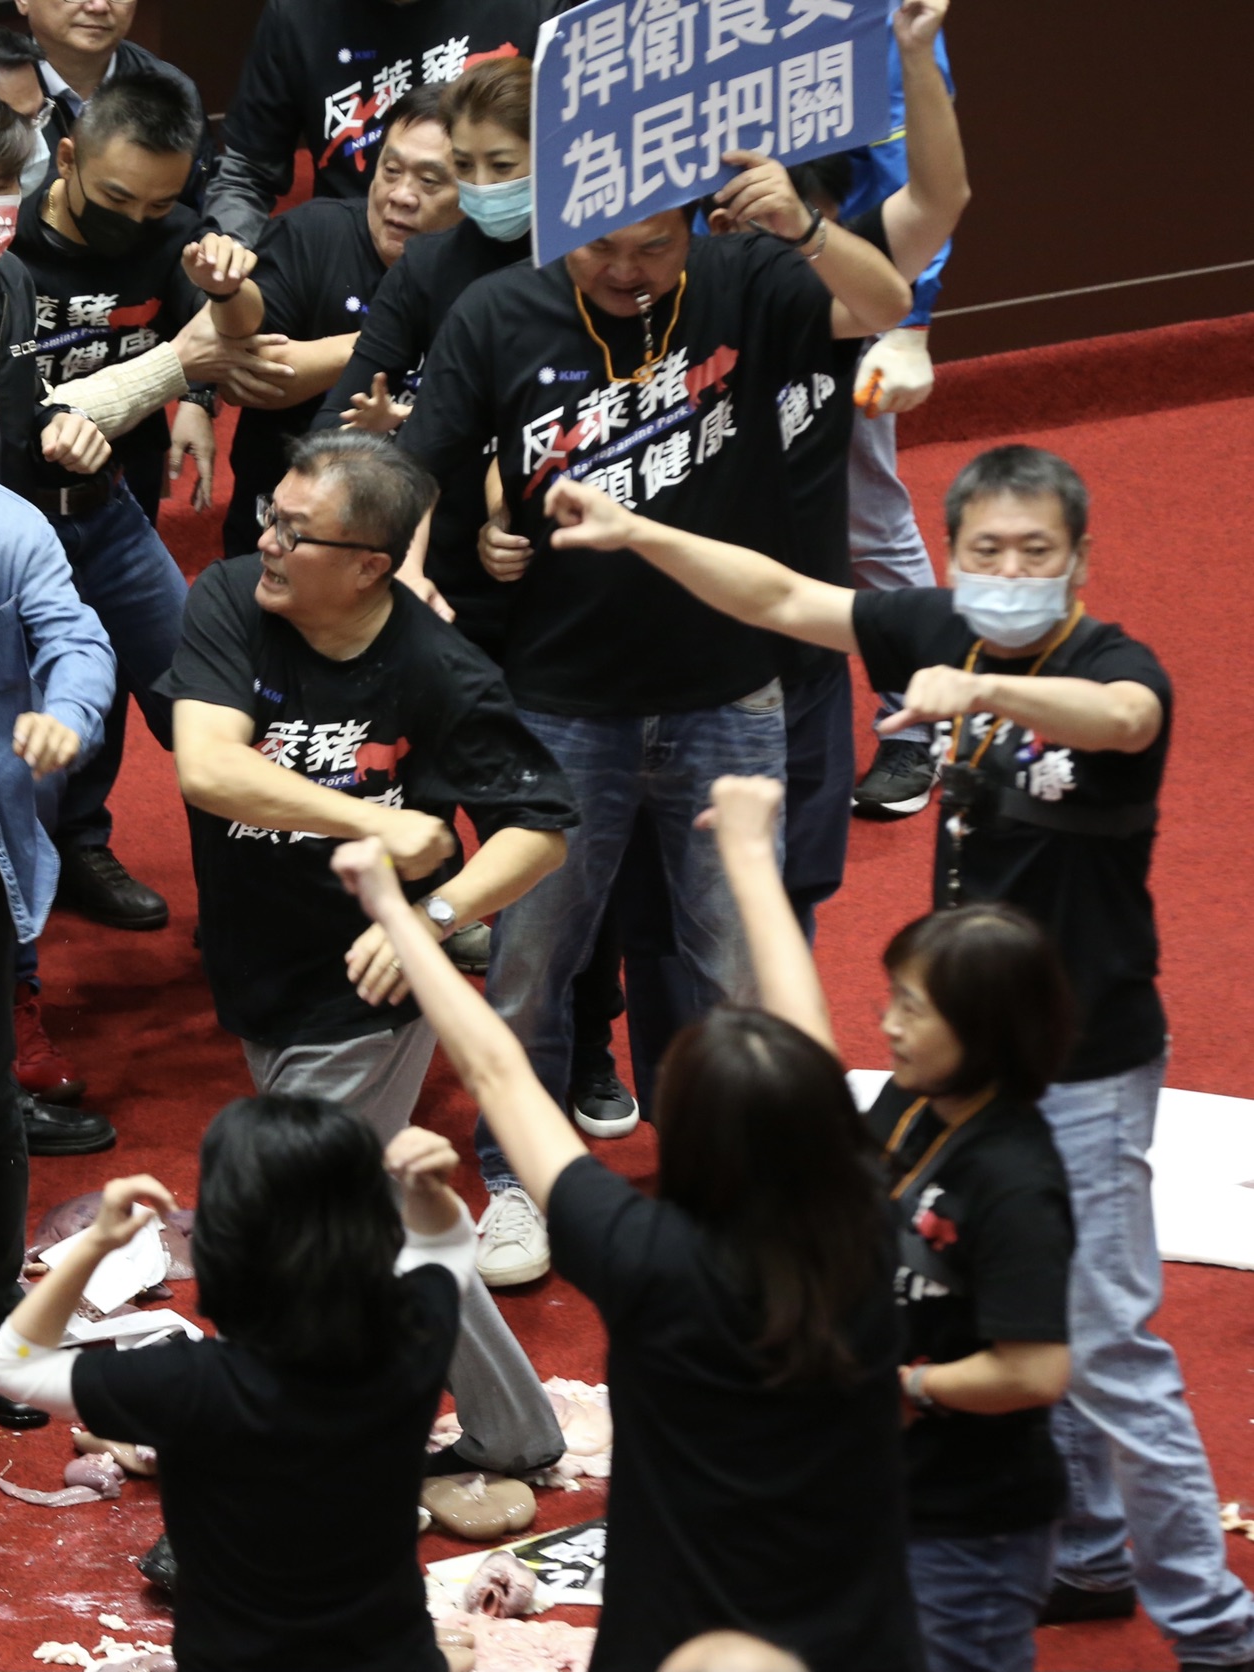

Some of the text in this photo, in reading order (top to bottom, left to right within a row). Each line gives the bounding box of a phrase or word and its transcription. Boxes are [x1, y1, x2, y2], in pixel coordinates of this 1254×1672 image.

[324, 35, 470, 140] 反萊豬
[561, 40, 854, 228] 為民把關
[558, 370, 590, 381] KMT
[523, 346, 690, 475] 反萊豬
[656, 404, 689, 427] Pork
[261, 687, 284, 703] KM
[318, 774, 352, 787] Pork
